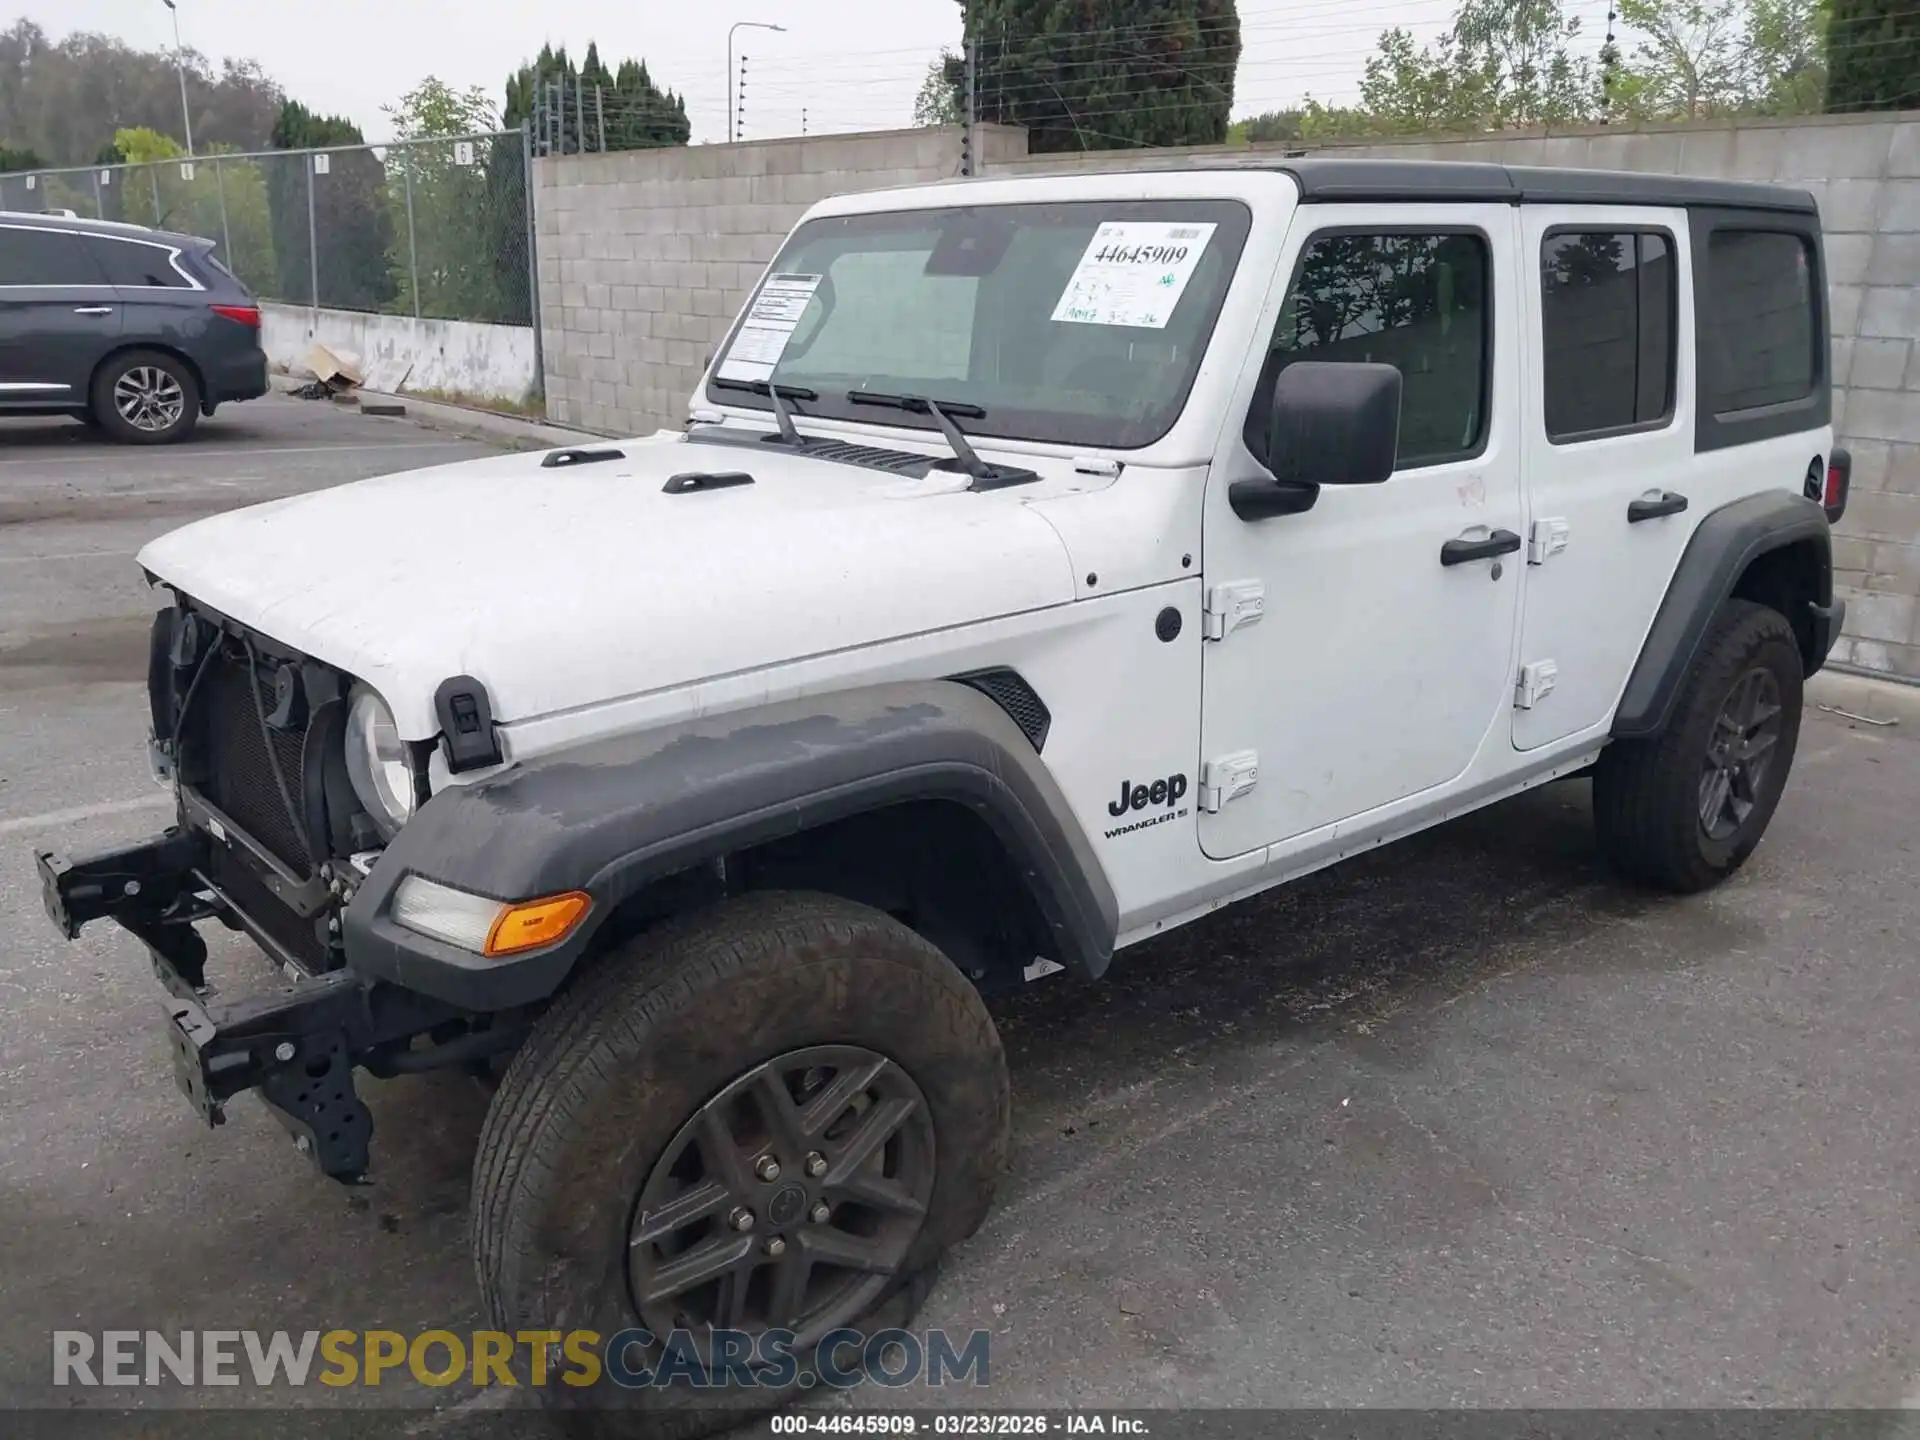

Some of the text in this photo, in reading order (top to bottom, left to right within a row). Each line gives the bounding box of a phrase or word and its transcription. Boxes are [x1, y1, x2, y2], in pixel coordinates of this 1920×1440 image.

[1095, 244, 1188, 264] 44645909
[1108, 773, 1187, 817] Jeep
[1104, 812, 1176, 839] WRANGLER
